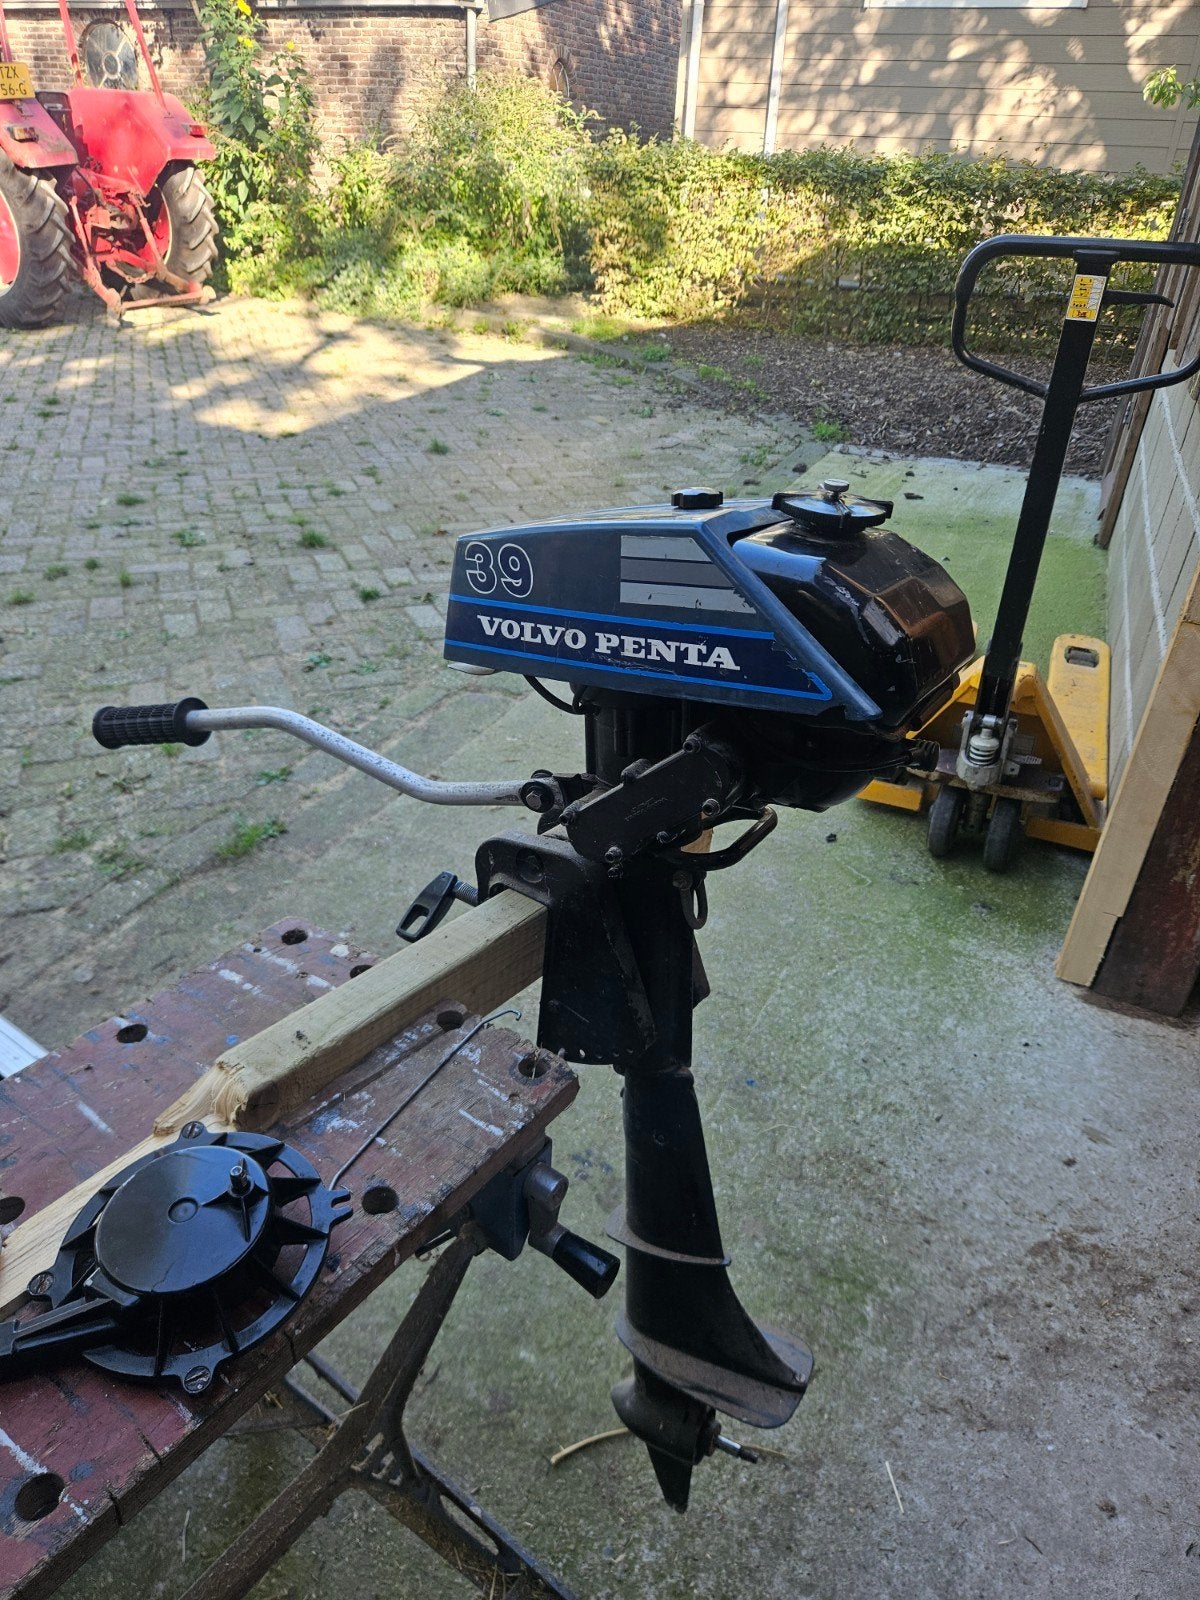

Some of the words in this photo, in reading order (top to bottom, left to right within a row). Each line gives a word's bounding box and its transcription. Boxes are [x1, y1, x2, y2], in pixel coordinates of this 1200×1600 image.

[464, 541, 534, 598] 39
[477, 615, 587, 650] VOLVO
[595, 632, 741, 671] PENTA
